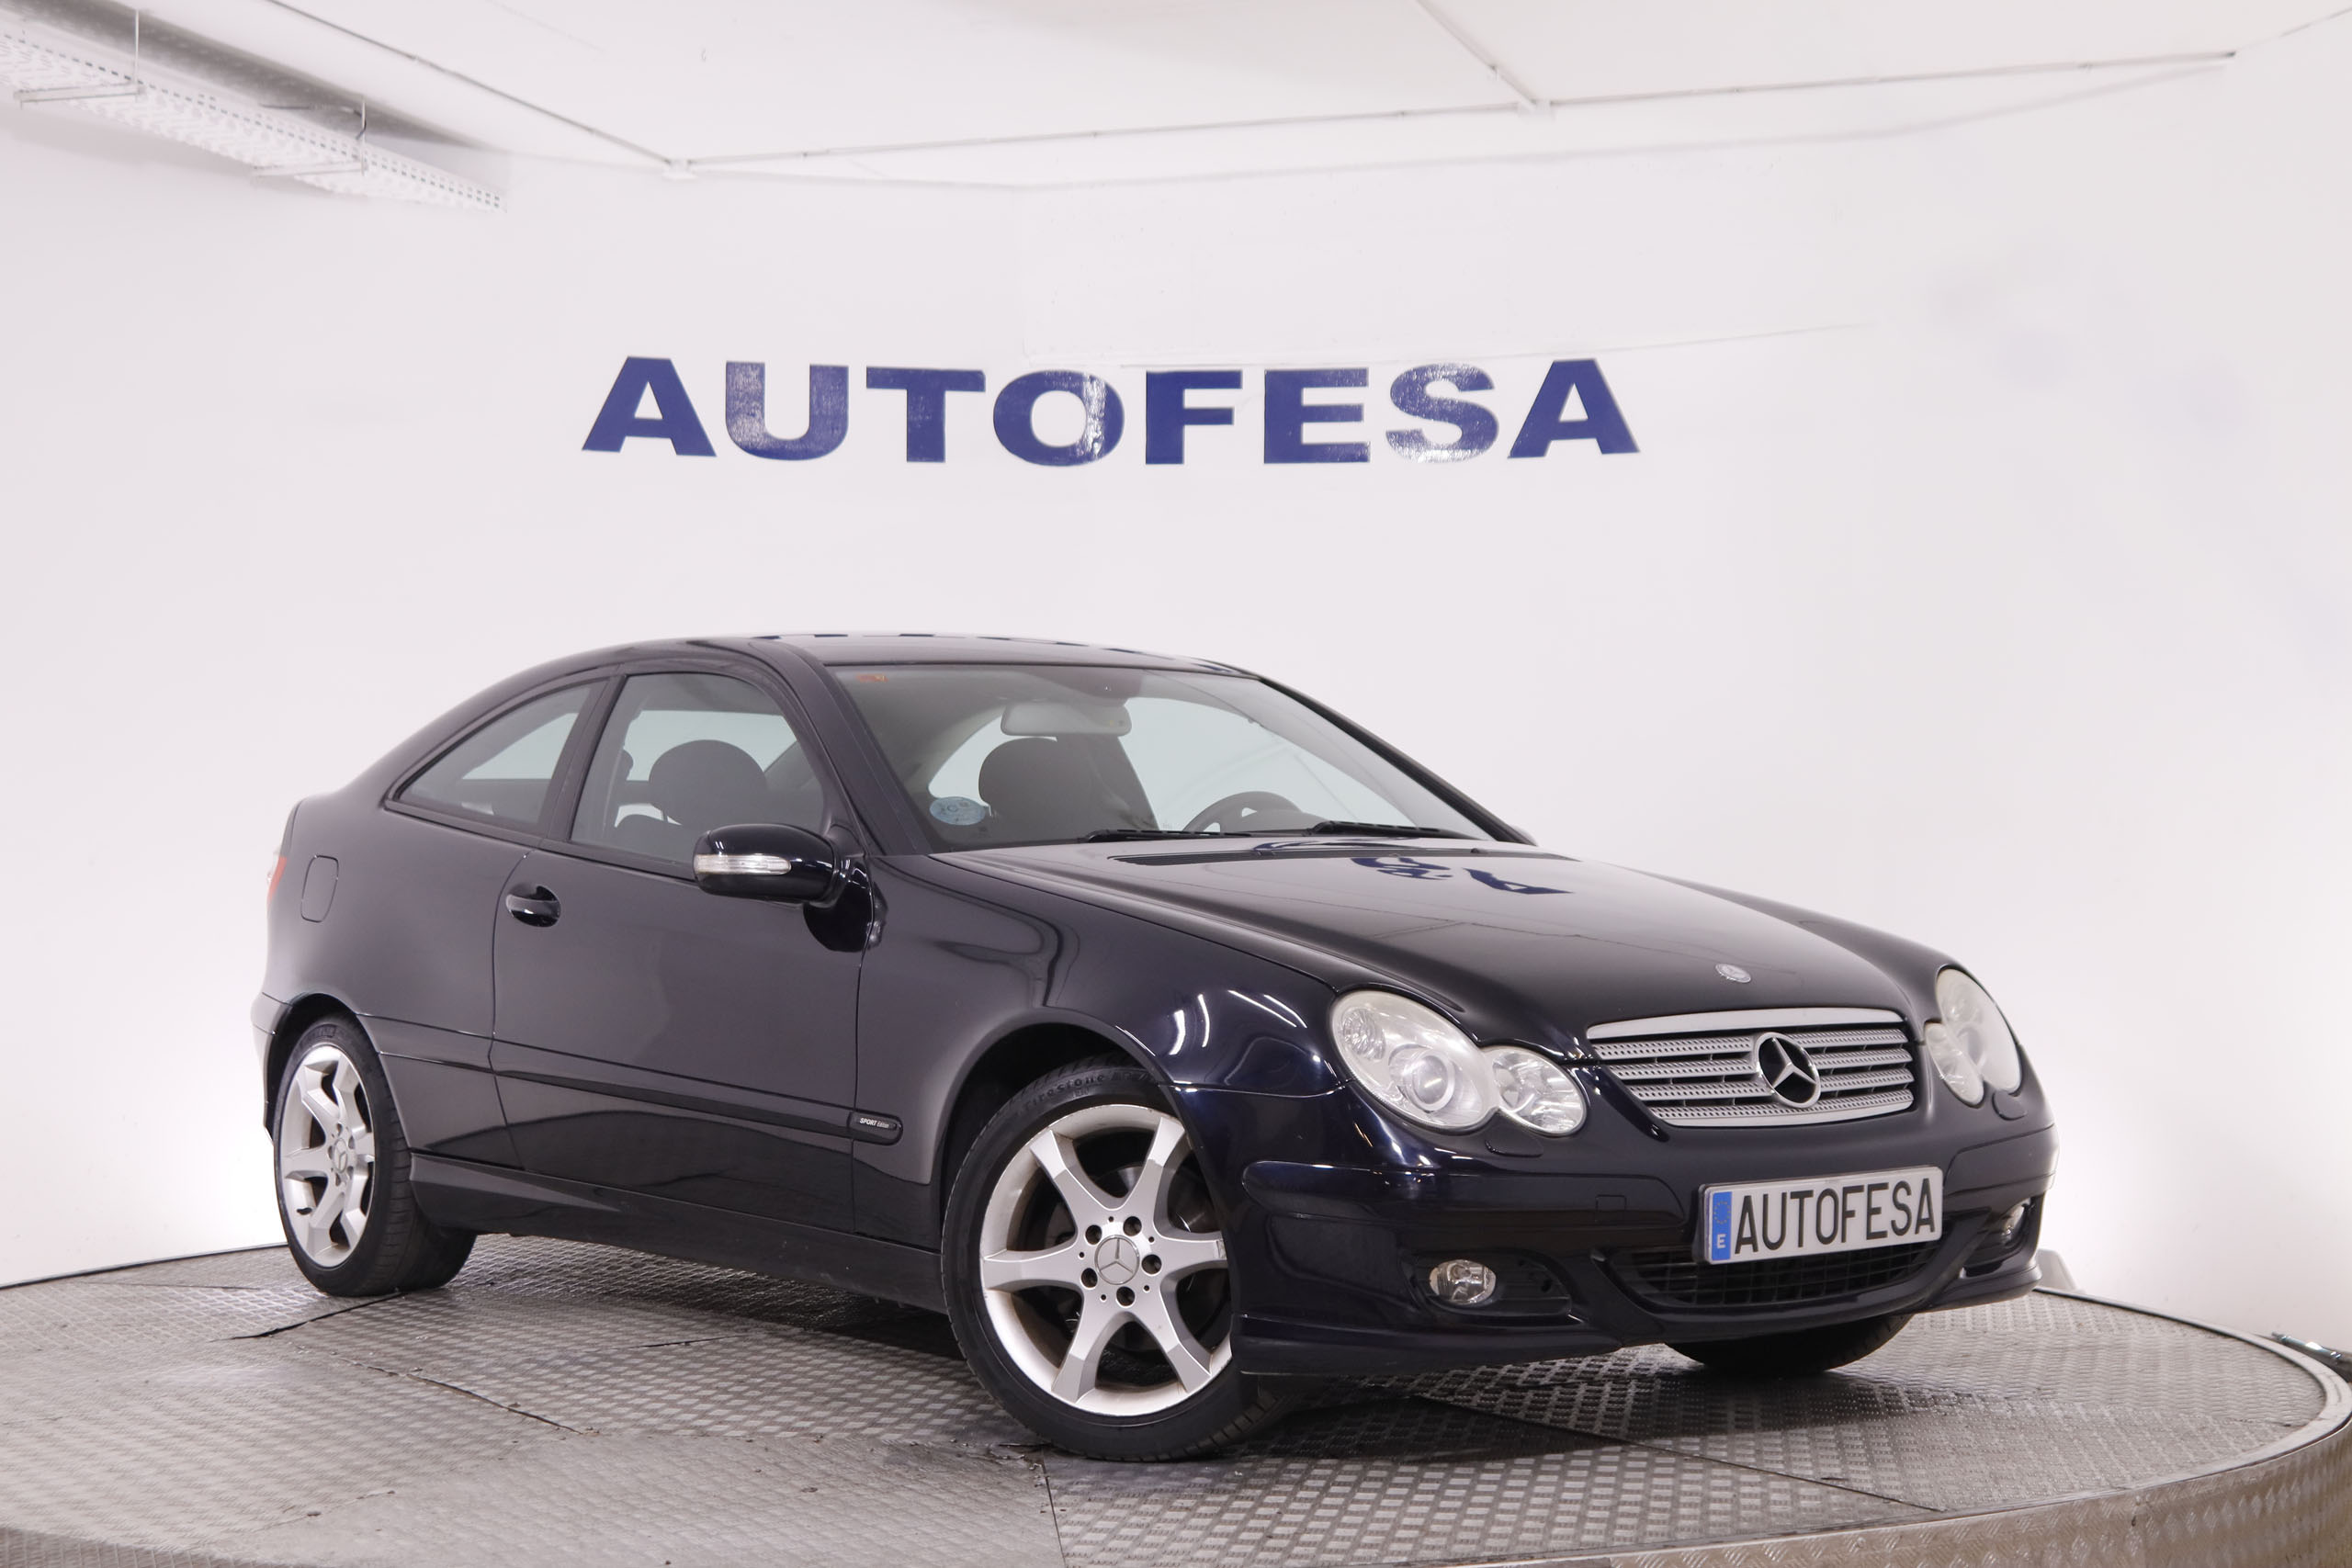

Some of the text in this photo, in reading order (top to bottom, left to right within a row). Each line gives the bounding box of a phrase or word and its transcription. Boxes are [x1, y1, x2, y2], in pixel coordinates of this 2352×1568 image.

[581, 355, 1641, 467] AUTOFESA
[859, 1117, 877, 1126] SPORT
[1734, 1178, 1936, 1255] AUTOFESA
[1716, 1233, 1727, 1249] E
